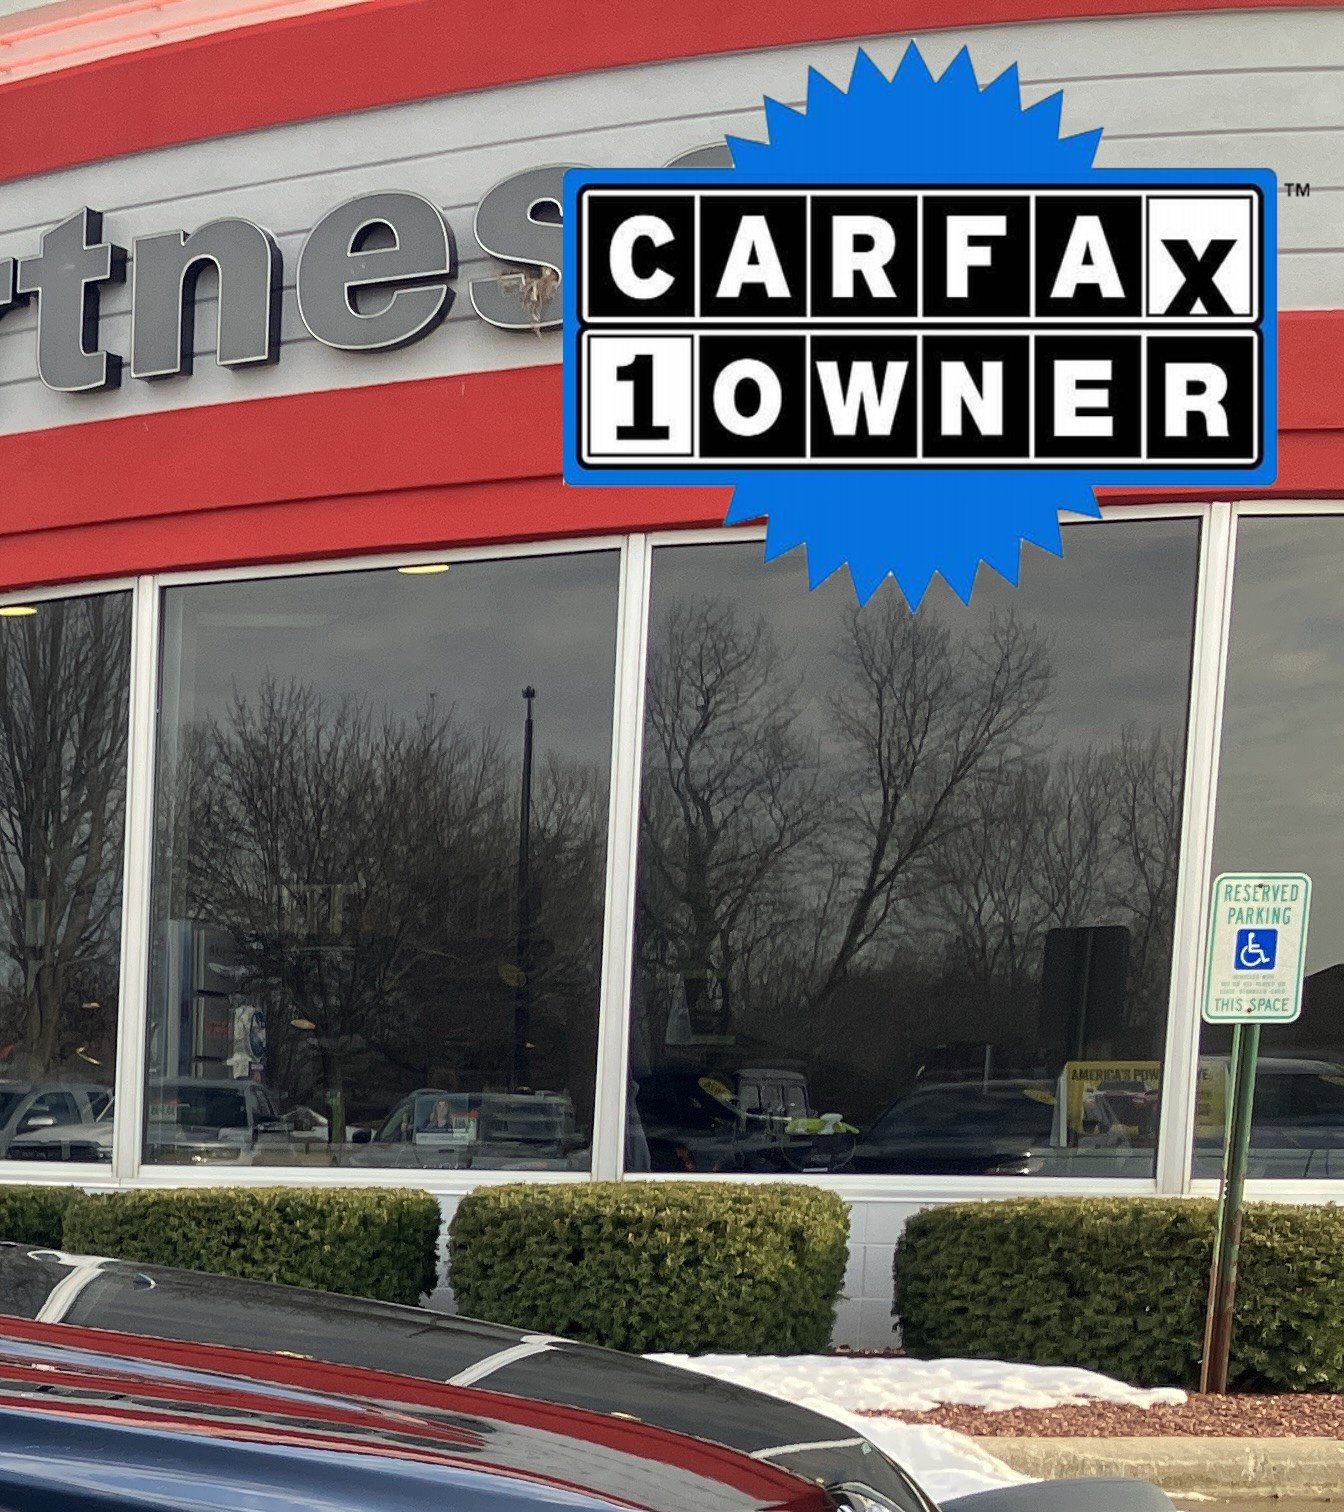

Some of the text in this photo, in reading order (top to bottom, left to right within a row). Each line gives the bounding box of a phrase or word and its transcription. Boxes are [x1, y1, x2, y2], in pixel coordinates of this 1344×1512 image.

[1223, 884, 1300, 903] RESERVED
[1227, 907, 1292, 925] PARKING
[1214, 998, 1290, 1013] THIS SPACE
